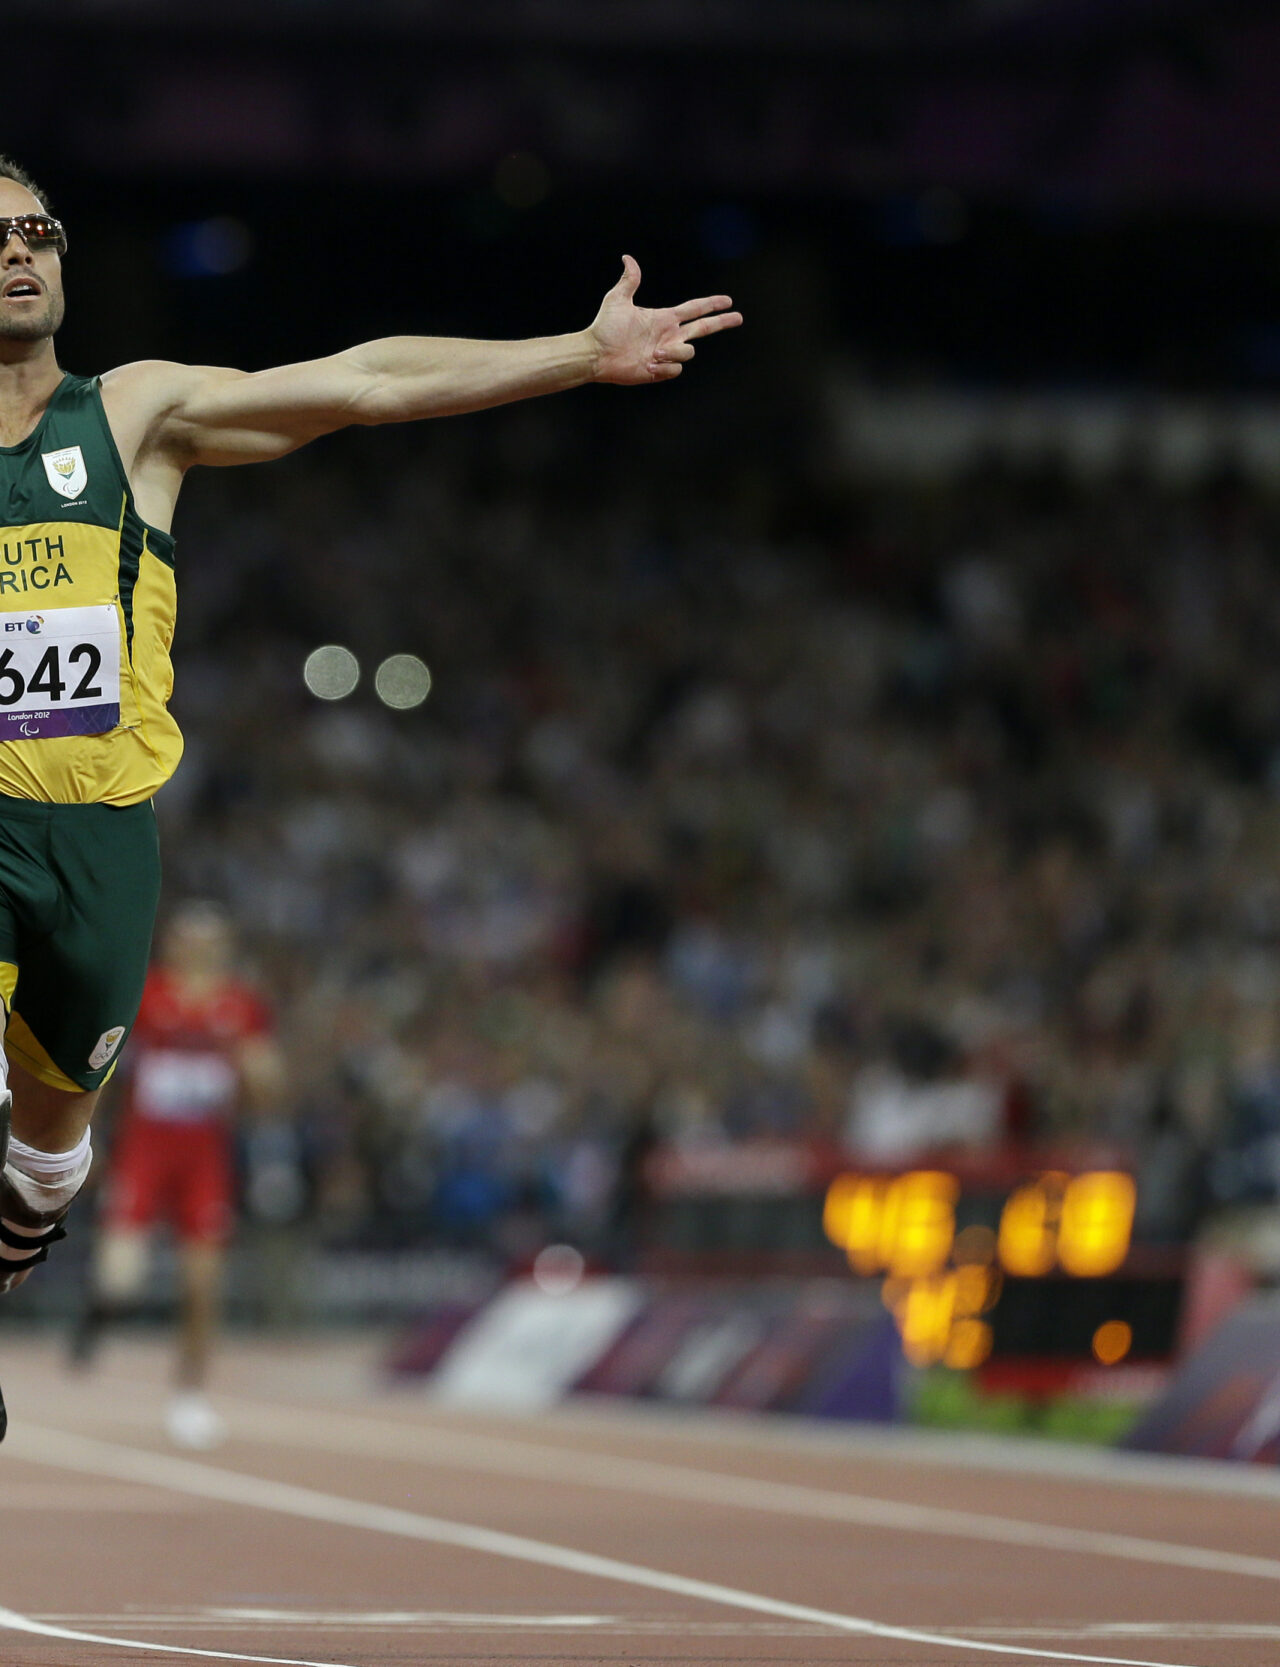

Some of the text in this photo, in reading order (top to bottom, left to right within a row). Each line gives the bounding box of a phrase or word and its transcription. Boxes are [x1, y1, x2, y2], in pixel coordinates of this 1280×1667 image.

[5, 622, 25, 632] BT
[7, 711, 50, 721] London 2012
